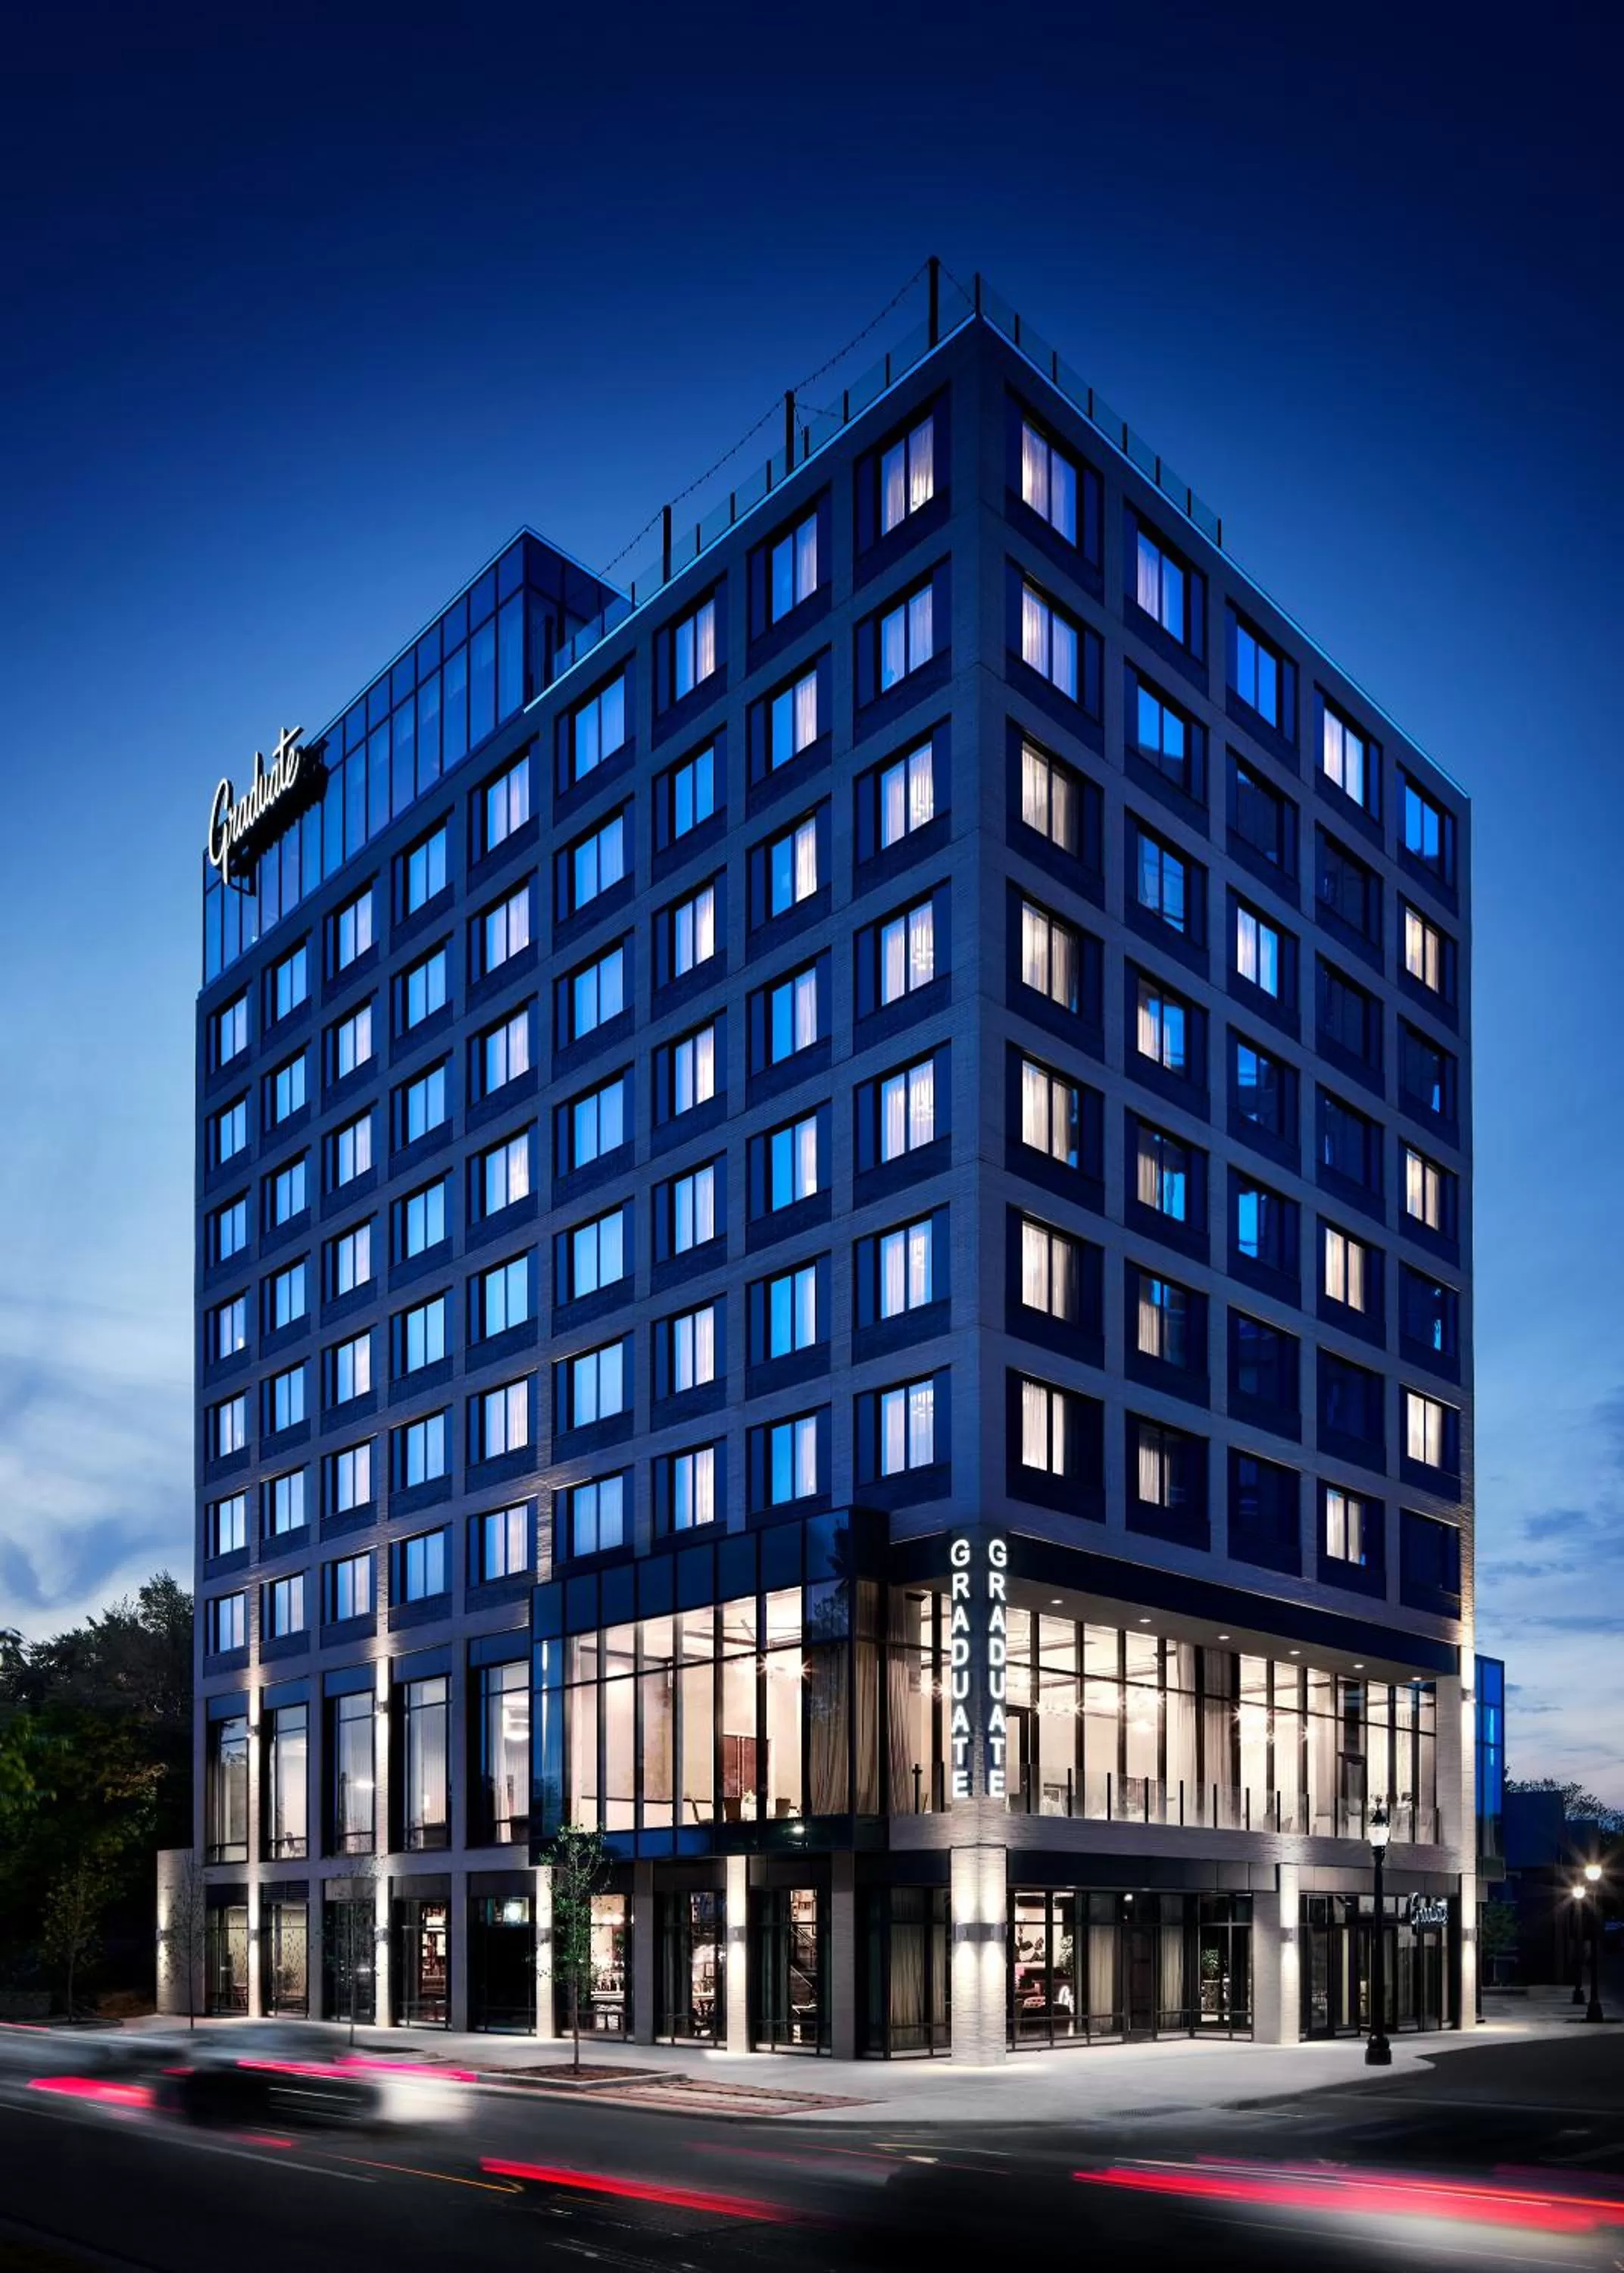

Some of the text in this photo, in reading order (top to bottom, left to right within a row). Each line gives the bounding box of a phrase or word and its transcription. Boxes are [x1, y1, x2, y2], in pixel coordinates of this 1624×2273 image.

[208, 726, 303, 885] Graduate
[951, 1539, 970, 1798] GRADUATE
[988, 1539, 1007, 1798] GRADUATE
